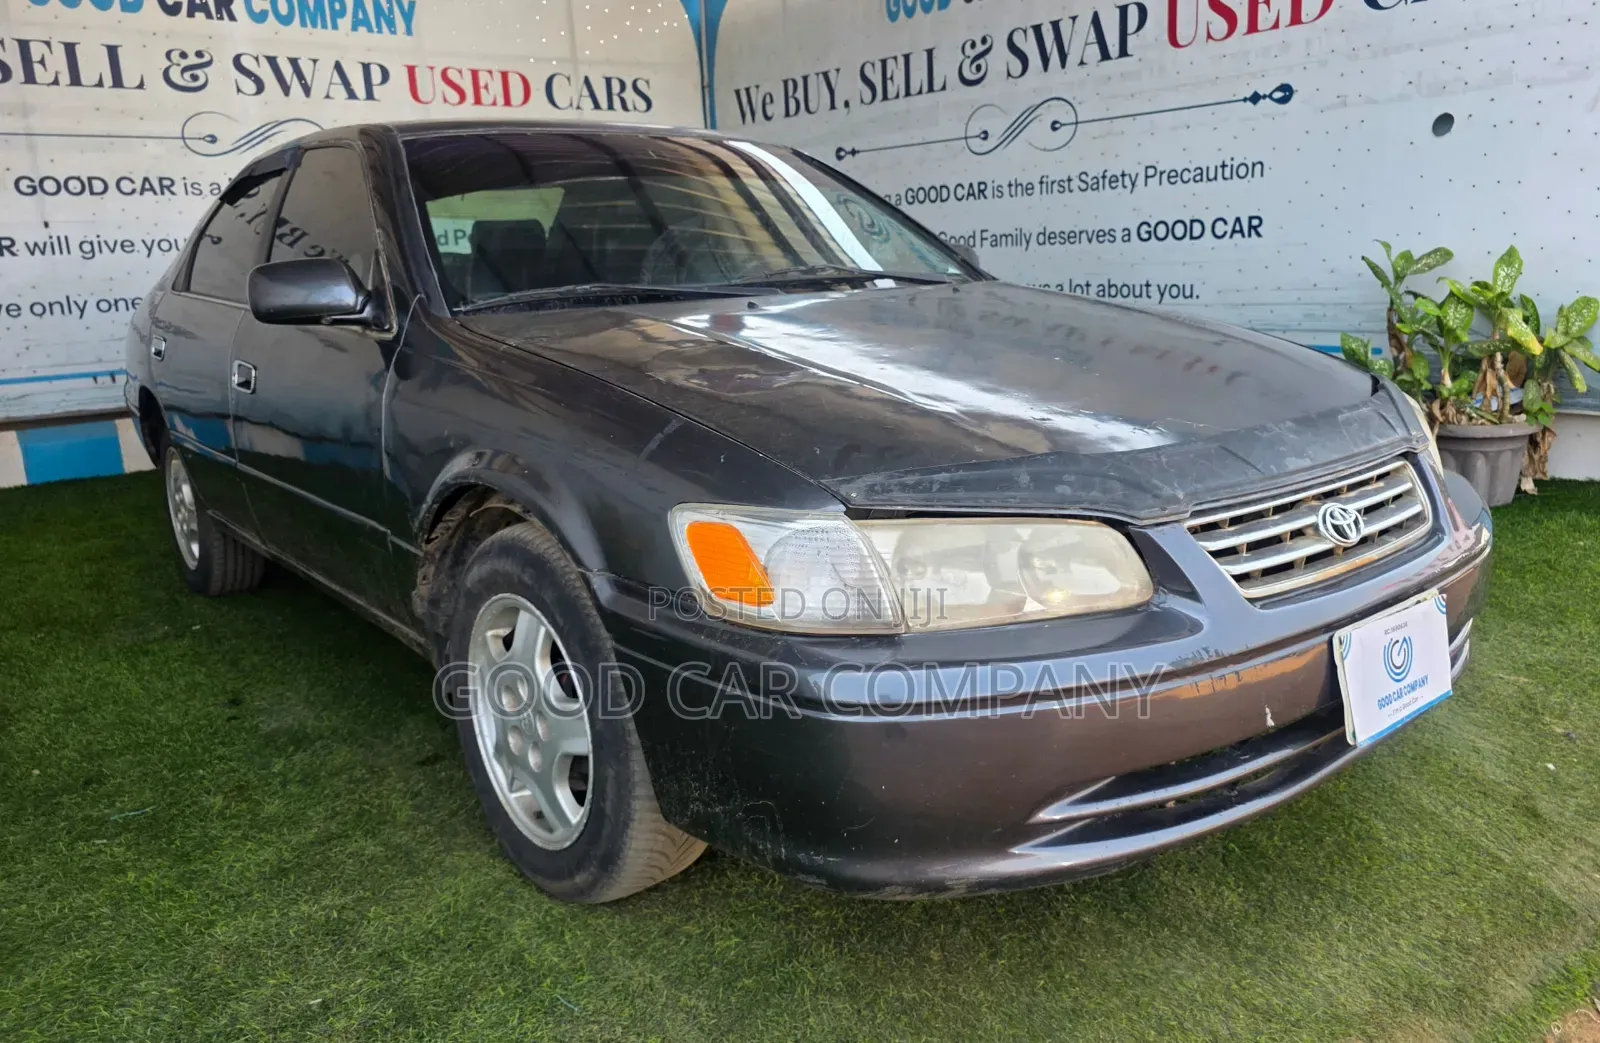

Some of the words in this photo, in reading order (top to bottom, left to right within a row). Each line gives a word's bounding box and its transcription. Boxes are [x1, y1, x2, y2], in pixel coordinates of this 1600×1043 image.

[245, 0, 416, 36] COMPANY
[162, 48, 214, 93] &
[231, 52, 390, 102] SWAP
[404, 64, 532, 108] USED
[545, 72, 653, 113] CARS
[734, 84, 775, 126] We
[782, 68, 850, 119] BUY,
[859, 47, 947, 106] SELL
[957, 34, 994, 87] &
[1006, 1, 1148, 80] SWAP
[13, 175, 109, 197] GOOD
[115, 176, 177, 197] CAR
[182, 176, 203, 196] is
[209, 182, 222, 196] a
[904, 184, 950, 206] GOOD
[953, 181, 988, 202] CAR
[991, 180, 1004, 200] is
[1007, 176, 1035, 199] the
[1038, 174, 1074, 195] first
[1077, 165, 1139, 195] Safety
[1143, 158, 1265, 188] Precaution
[24, 235, 71, 257] will
[78, 234, 135, 260] give
[980, 227, 1032, 252] Family
[1036, 226, 1117, 247] deserves
[1121, 227, 1132, 244] a
[1136, 218, 1205, 243] GOOD
[1211, 215, 1264, 239] CAR
[29, 295, 88, 319] only
[1096, 278, 1152, 299] about
[1157, 283, 1200, 304] you.
[1377, 692, 1393, 710] GOOD
[1392, 687, 1403, 702] CAR
[1403, 674, 1428, 696] COMPANY
